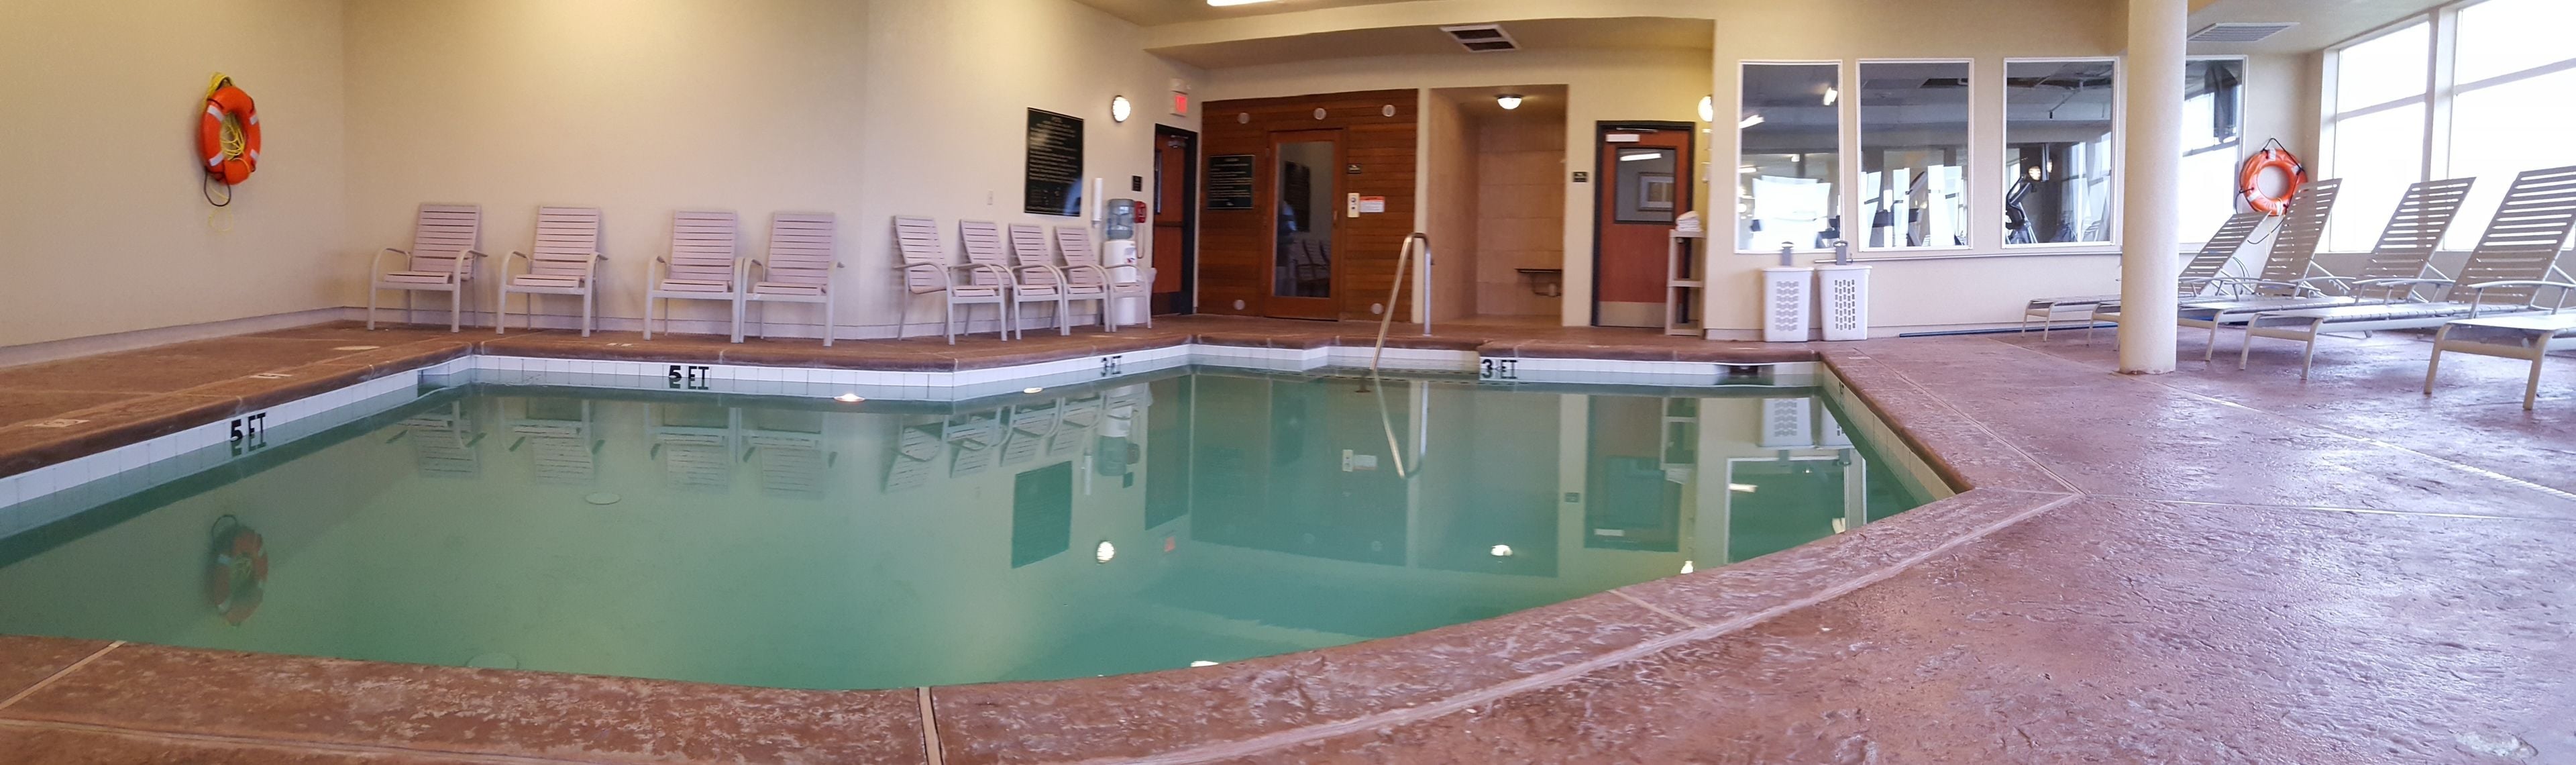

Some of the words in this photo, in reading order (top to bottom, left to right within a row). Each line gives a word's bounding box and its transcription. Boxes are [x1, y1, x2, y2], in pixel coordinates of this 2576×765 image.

[669, 365, 682, 378] 5
[688, 366, 709, 380] FT
[1481, 359, 1493, 371] 3
[230, 419, 243, 442] 5
[248, 412, 266, 438] FT
